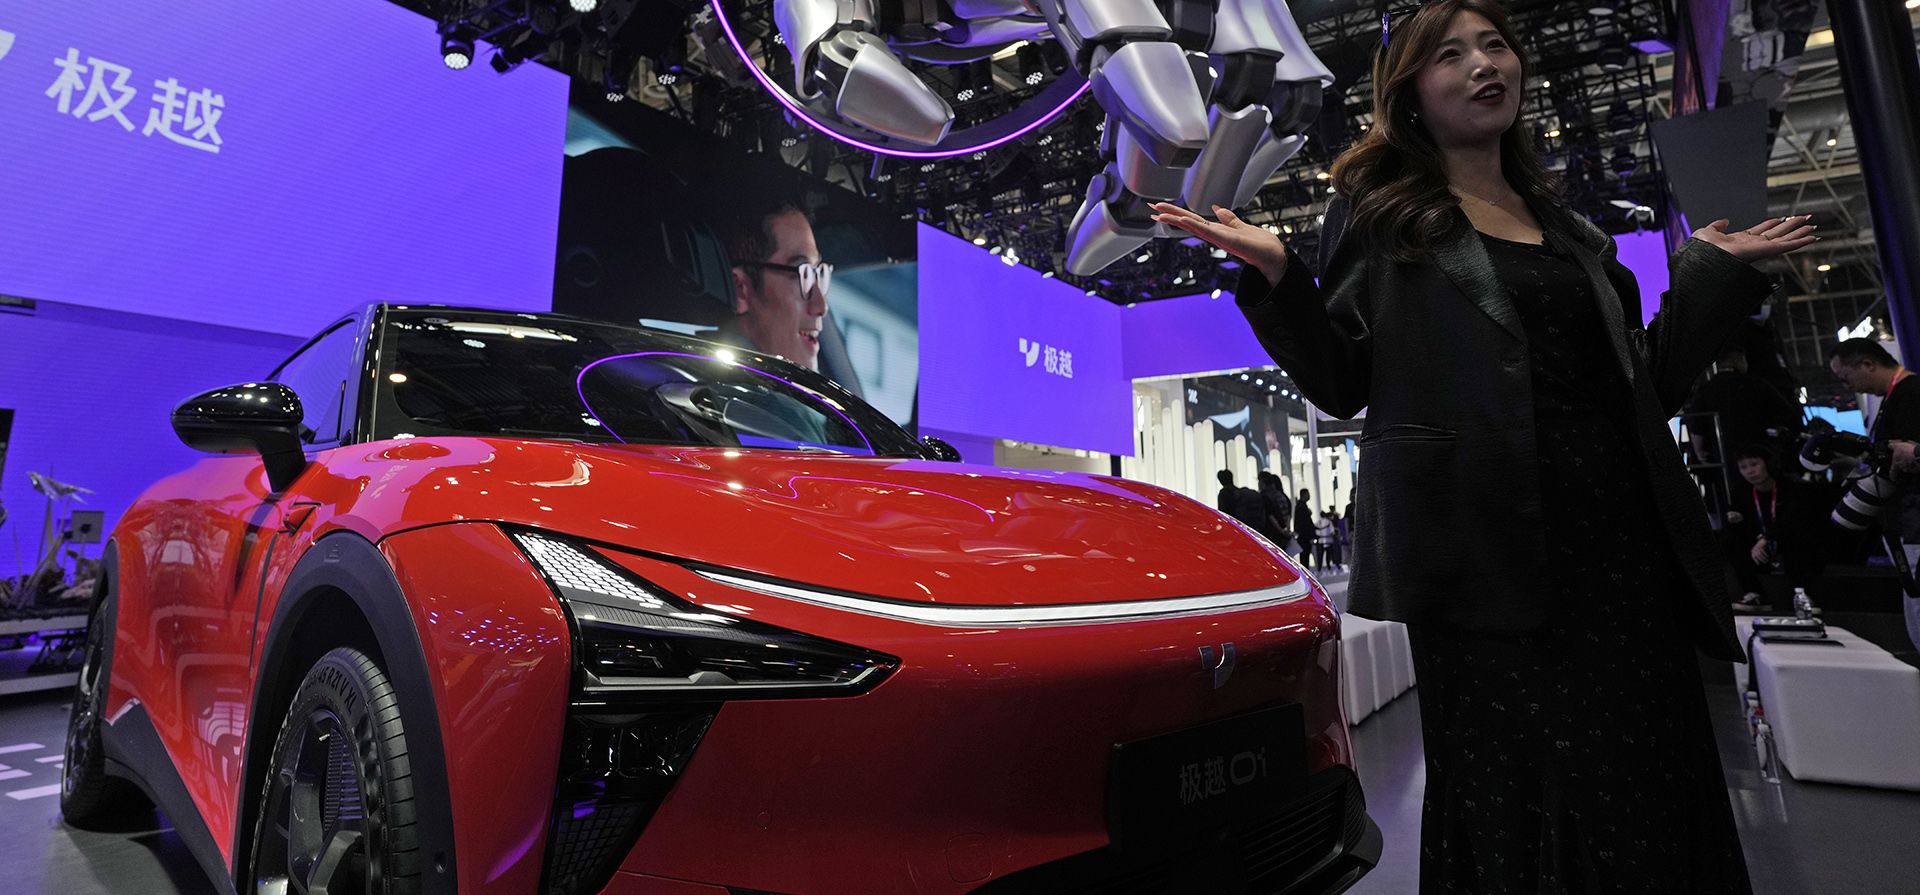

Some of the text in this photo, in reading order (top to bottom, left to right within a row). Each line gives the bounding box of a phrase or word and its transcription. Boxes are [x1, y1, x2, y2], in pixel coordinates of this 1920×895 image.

[45, 47, 226, 154] 极越
[1043, 344, 1074, 379] 极越
[344, 686, 358, 715] XL
